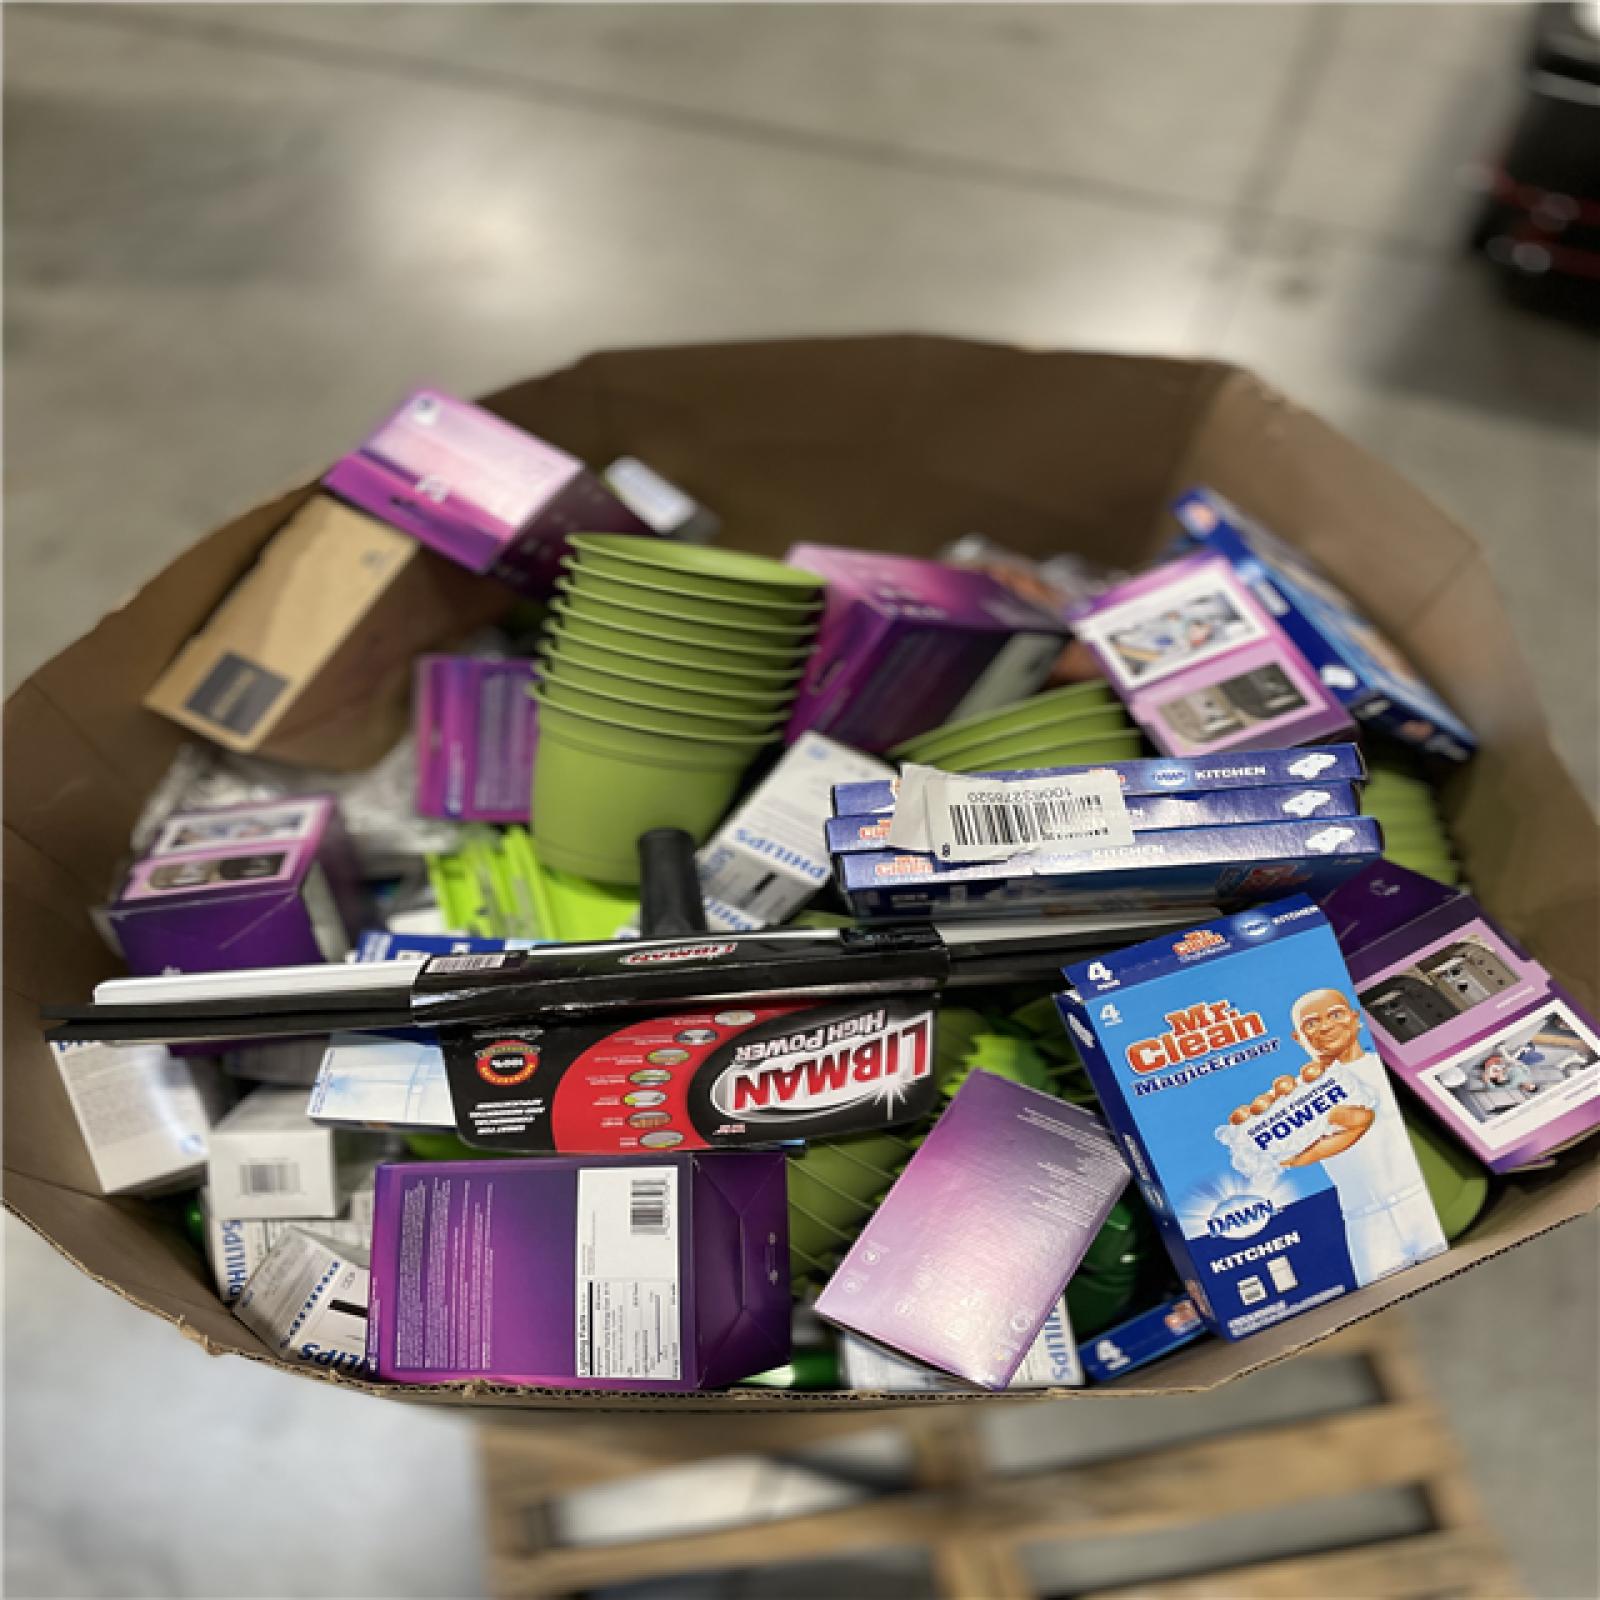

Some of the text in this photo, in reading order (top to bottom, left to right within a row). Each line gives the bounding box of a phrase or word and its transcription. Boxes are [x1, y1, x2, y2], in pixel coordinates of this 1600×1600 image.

[1088, 960, 1113, 981] 4
[1100, 1003, 1121, 1021] 4
[1164, 1000, 1239, 1037] Mr.
[735, 1009, 887, 1062] HIGH POWER
[1126, 1011, 1268, 1075] Clean
[733, 1012, 932, 1112] LIBMAN
[1254, 1084, 1349, 1150] POWER
[1207, 1199, 1275, 1237] DAWN
[1210, 1231, 1301, 1274] KITCHEN
